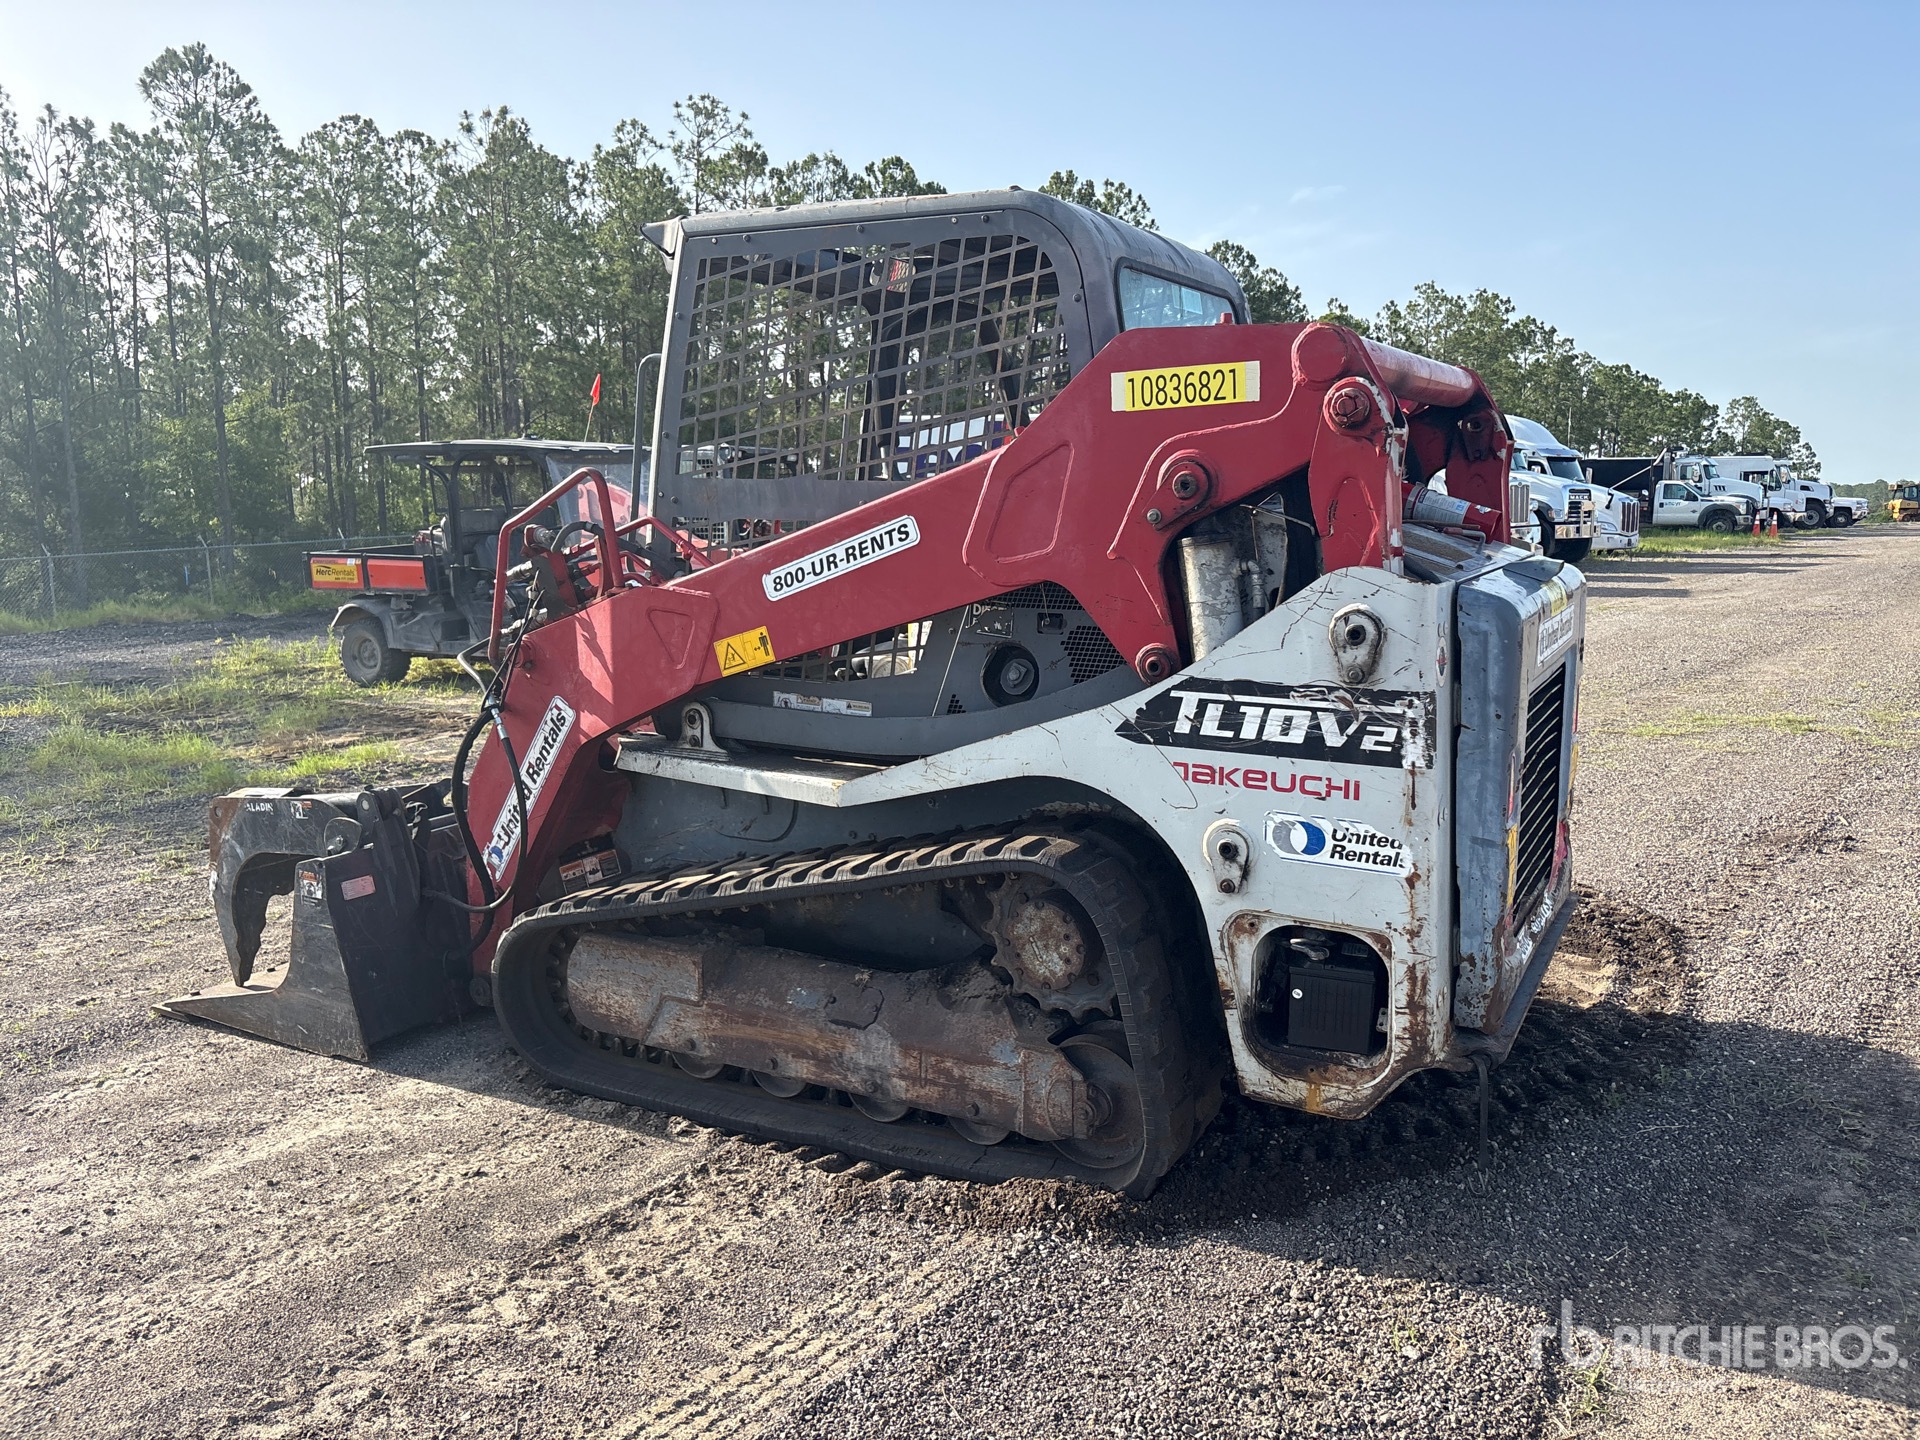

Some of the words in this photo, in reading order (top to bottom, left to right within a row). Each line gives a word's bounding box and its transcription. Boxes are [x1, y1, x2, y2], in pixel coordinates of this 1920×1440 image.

[1127, 368, 1238, 408] 10836821
[772, 523, 910, 593] 800-UR-RENTS
[244, 802, 274, 812] ALADIN
[497, 781, 533, 850] Unitd
[525, 710, 568, 785] Rentals
